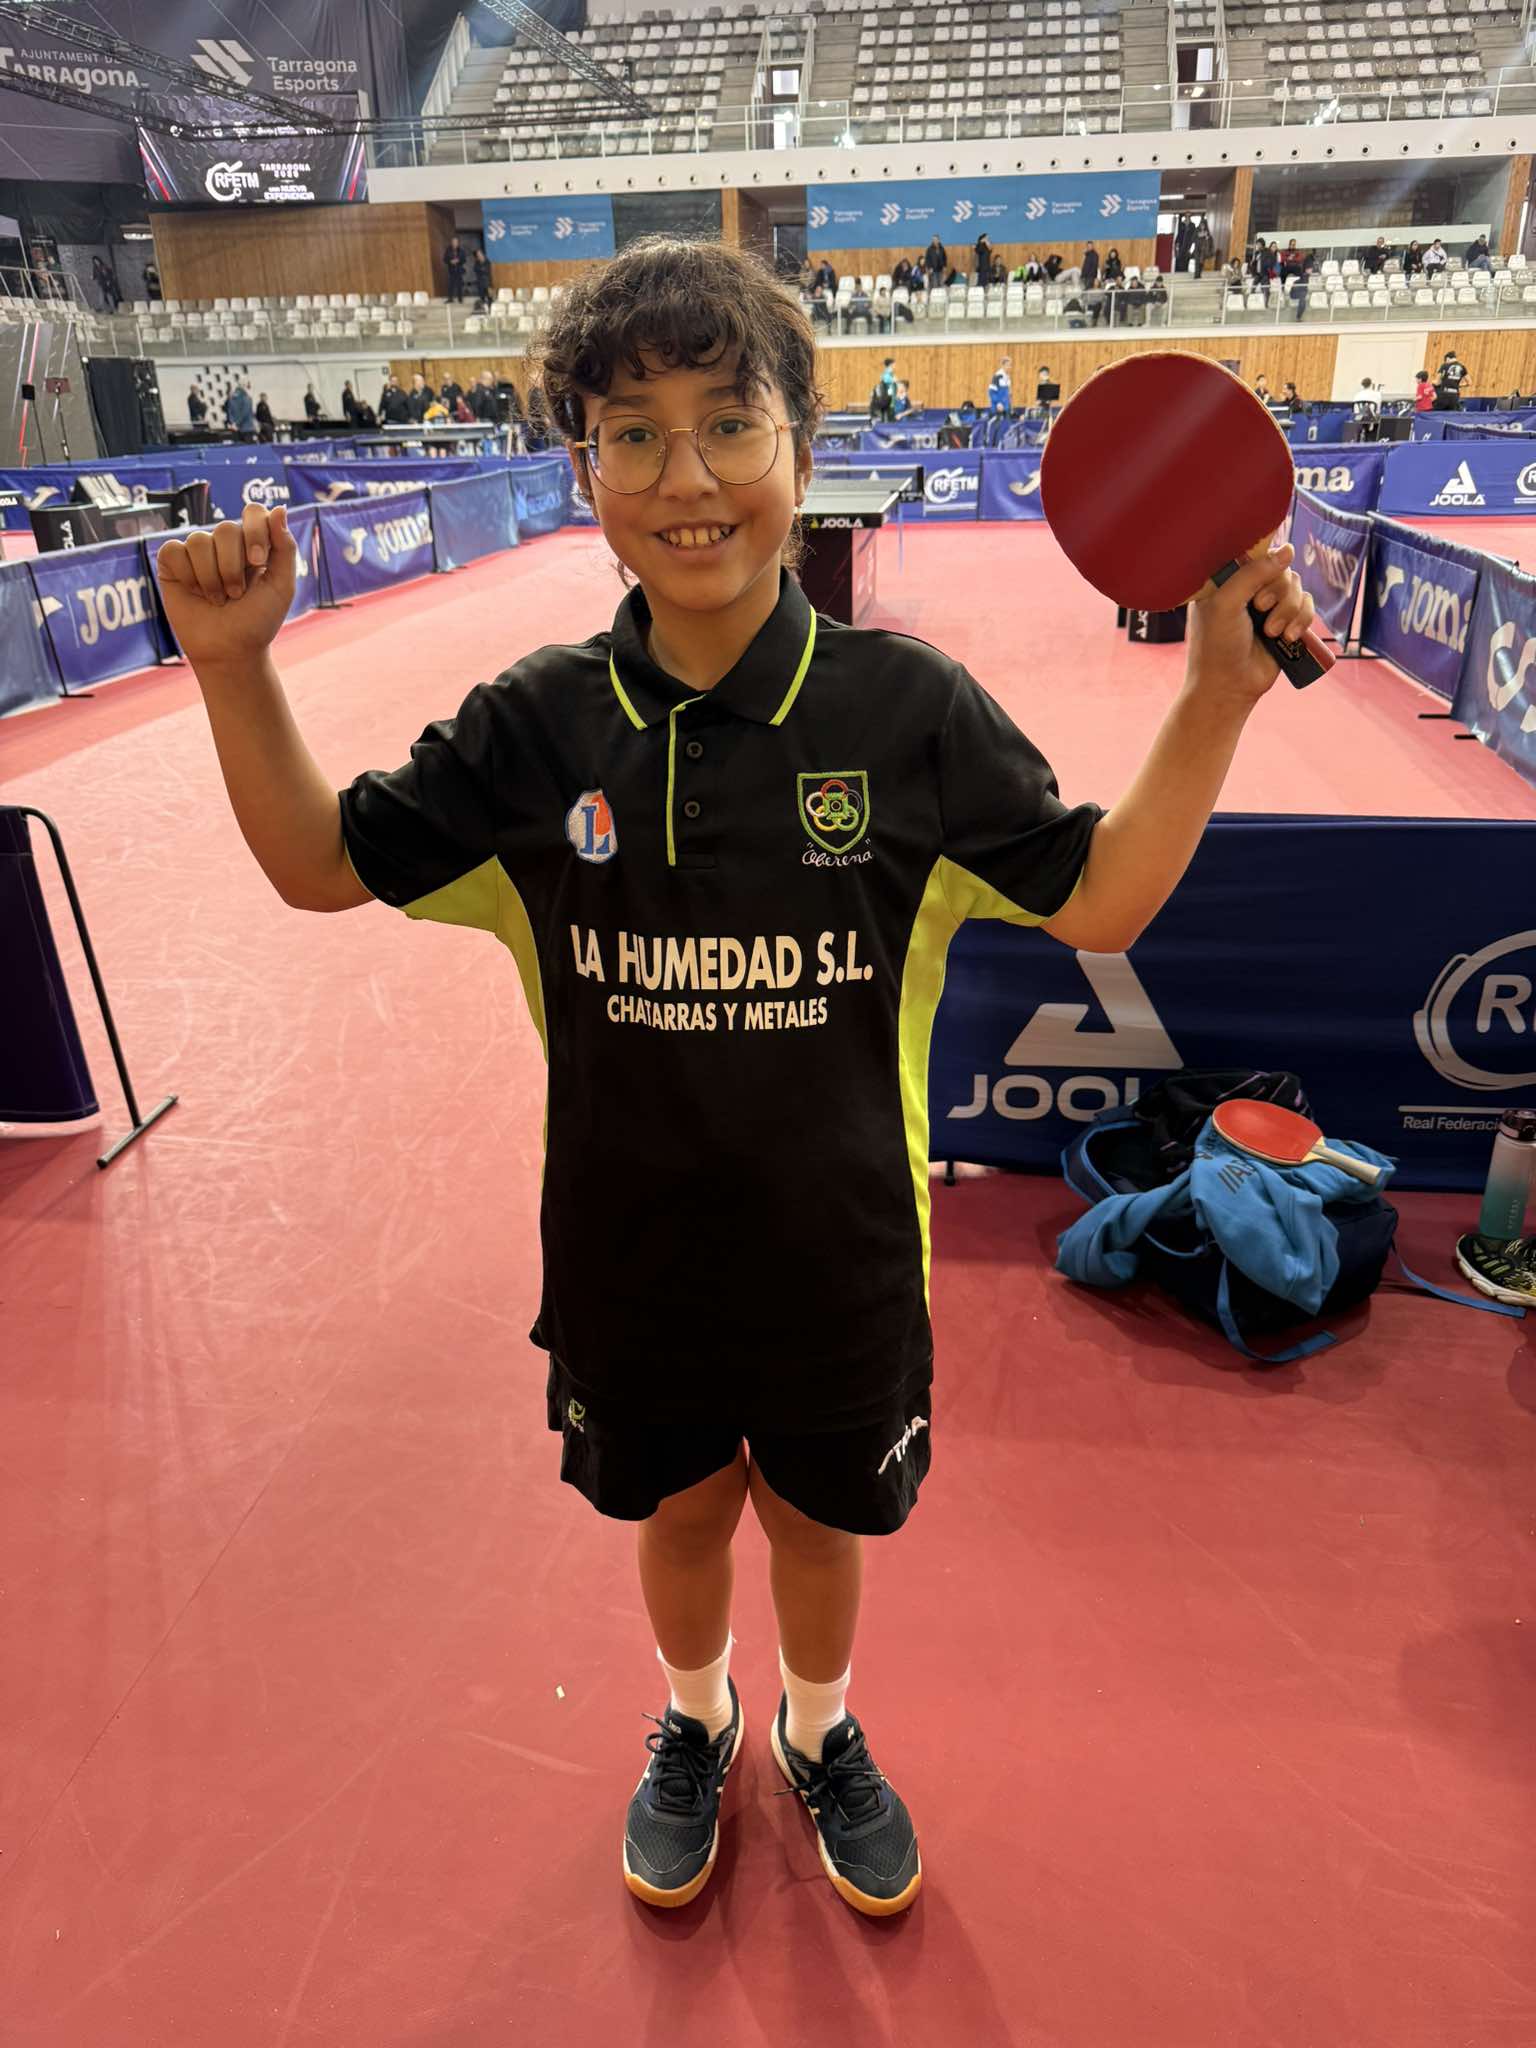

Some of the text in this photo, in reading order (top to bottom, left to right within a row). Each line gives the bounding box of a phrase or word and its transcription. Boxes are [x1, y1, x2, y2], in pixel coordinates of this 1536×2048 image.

[20, 48, 99, 63] AJUNTAMENT
[266, 56, 358, 75] Tarragona
[272, 75, 339, 94] Esports
[214, 172, 260, 188] RFETM
[933, 475, 979, 492] RFETM
[1428, 493, 1486, 506] JOOLA
[821, 516, 865, 528] JOOLA
[569, 924, 874, 991] LA HUMEDAD S.L.
[606, 994, 828, 1032] CHATARRAS Y METALES
[1403, 1115, 1499, 1131] Real Federaci
